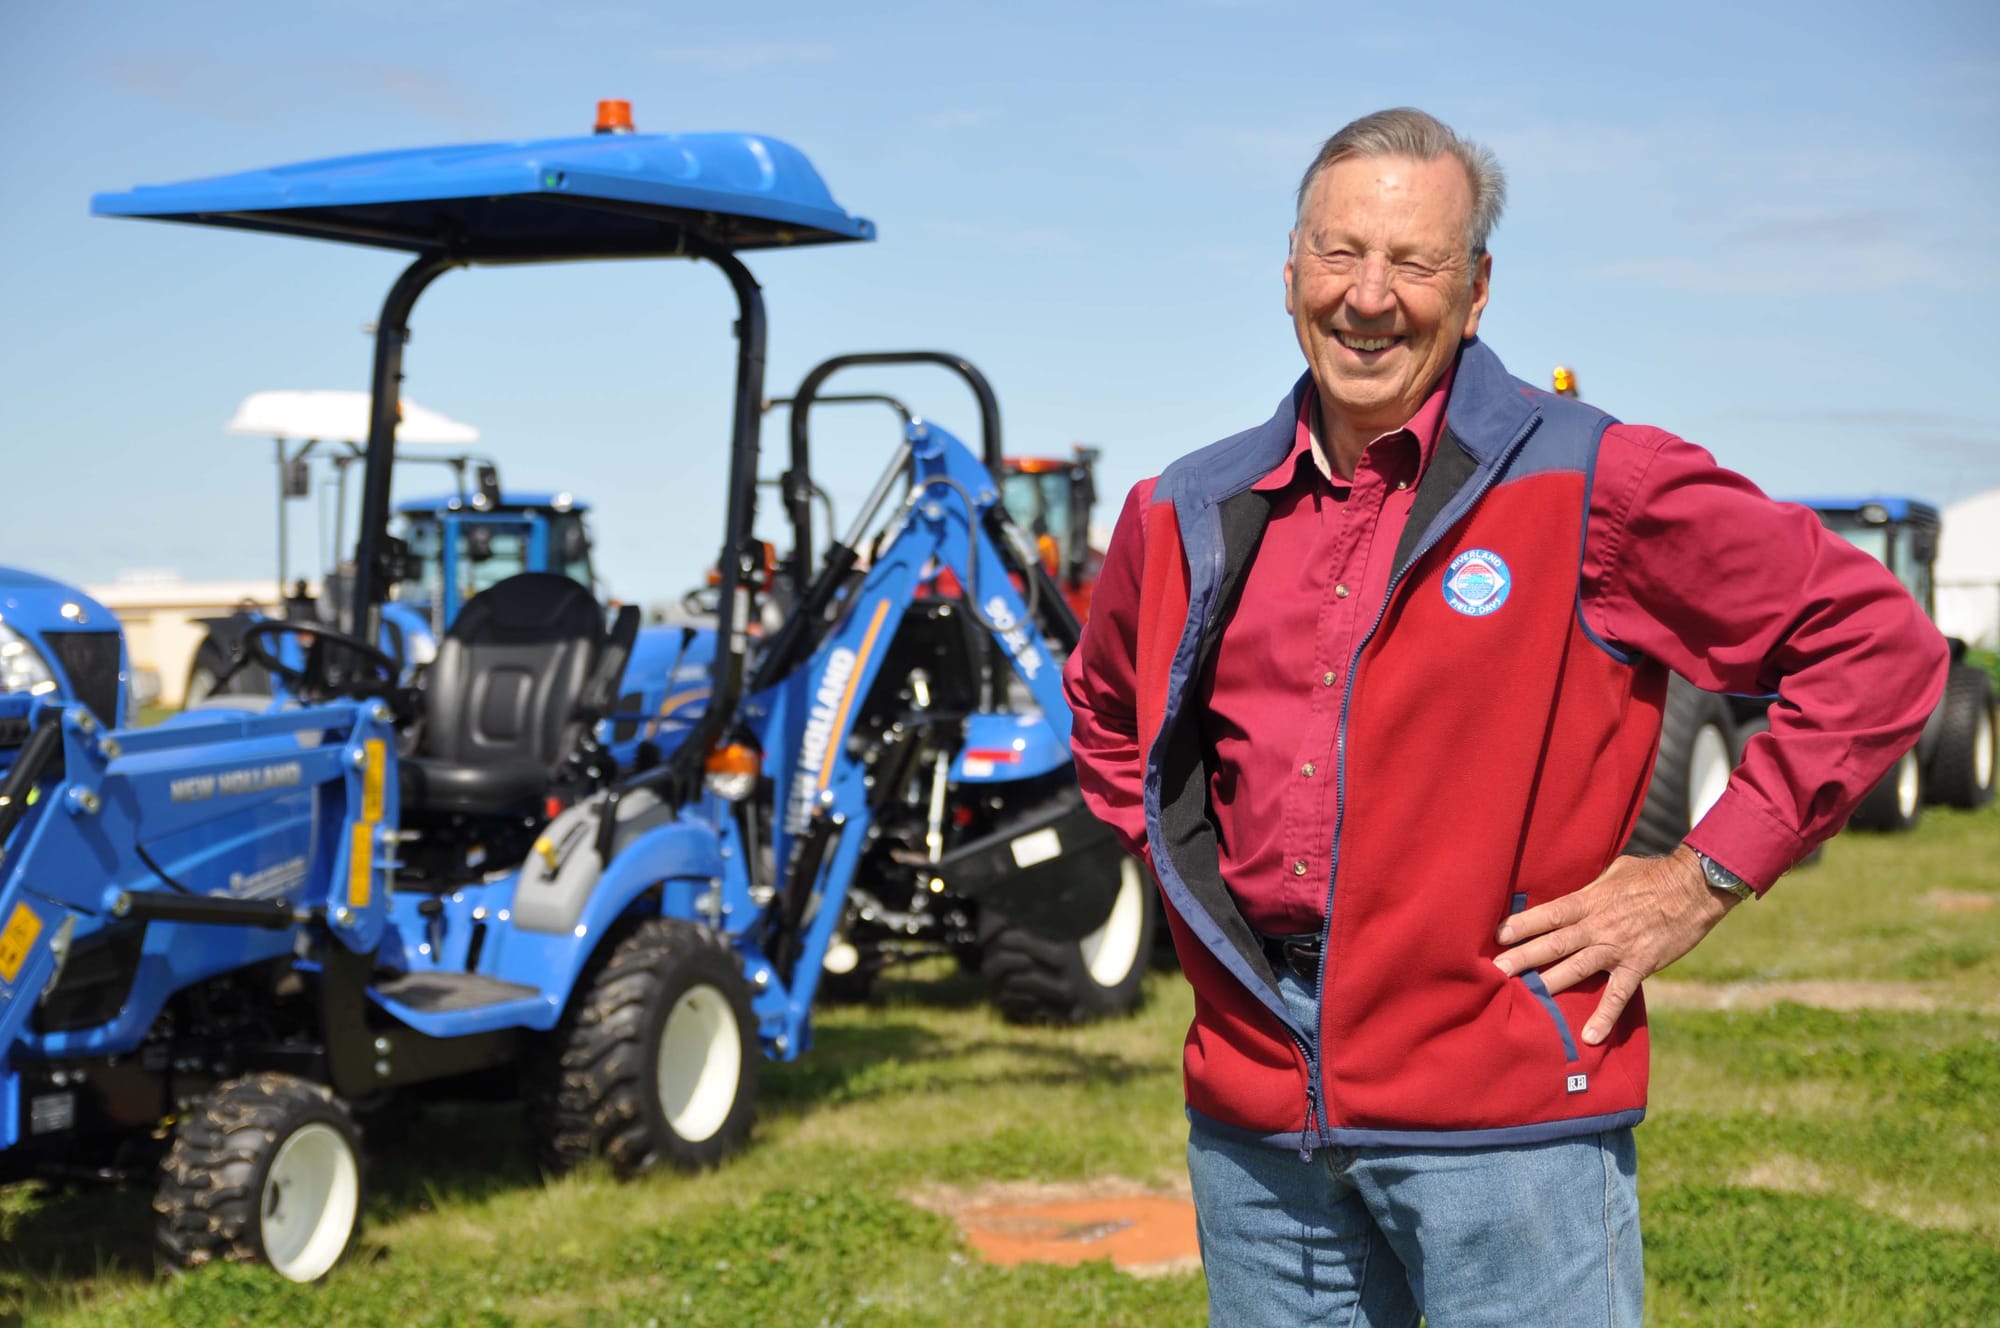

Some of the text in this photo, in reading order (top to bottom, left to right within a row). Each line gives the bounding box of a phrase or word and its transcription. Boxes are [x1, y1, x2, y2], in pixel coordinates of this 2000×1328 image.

[1450, 551, 1502, 570] RIVERLAND
[1450, 598, 1501, 614] FIELD DAYS
[797, 646, 857, 773] HOLLAND
[170, 761, 301, 805] NEW HOLLAND
